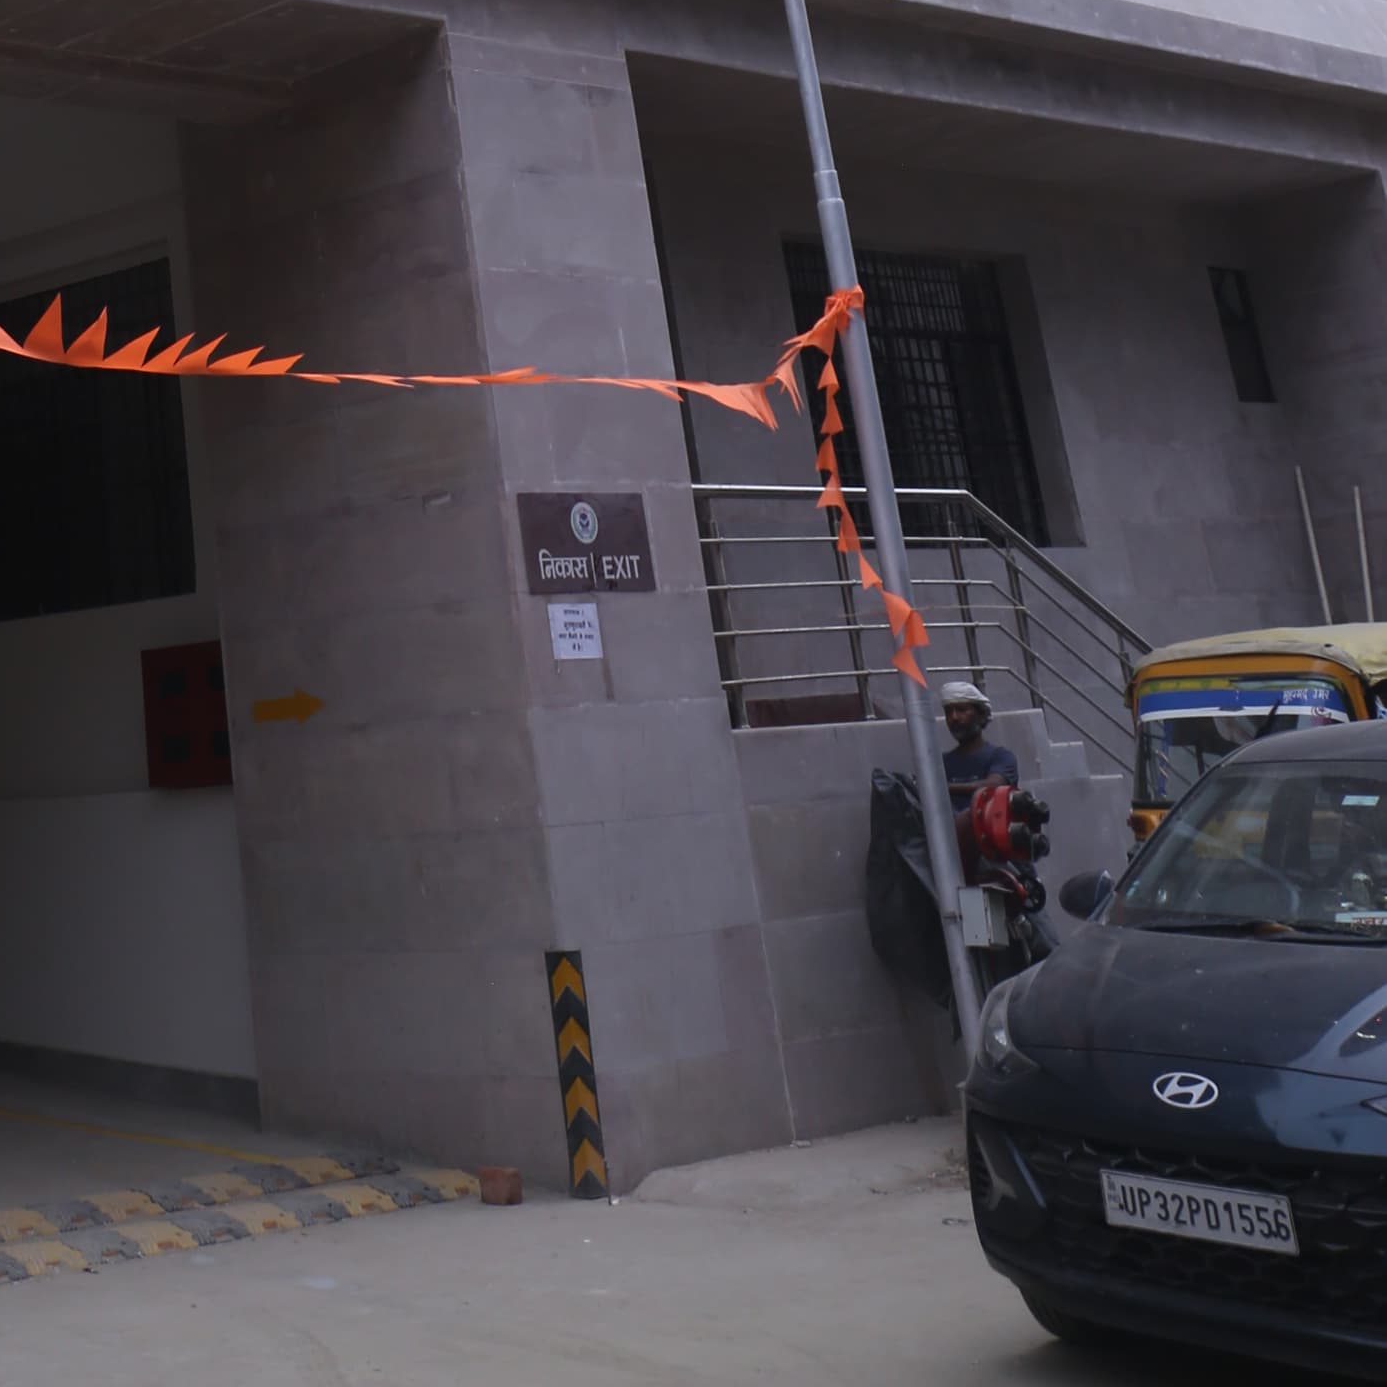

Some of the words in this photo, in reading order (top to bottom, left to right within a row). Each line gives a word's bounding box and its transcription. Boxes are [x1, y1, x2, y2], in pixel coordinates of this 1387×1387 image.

[538, 548, 589, 580] निकास
[602, 555, 640, 580] EXIT
[1119, 1184, 1291, 1241] UP32PD1556
